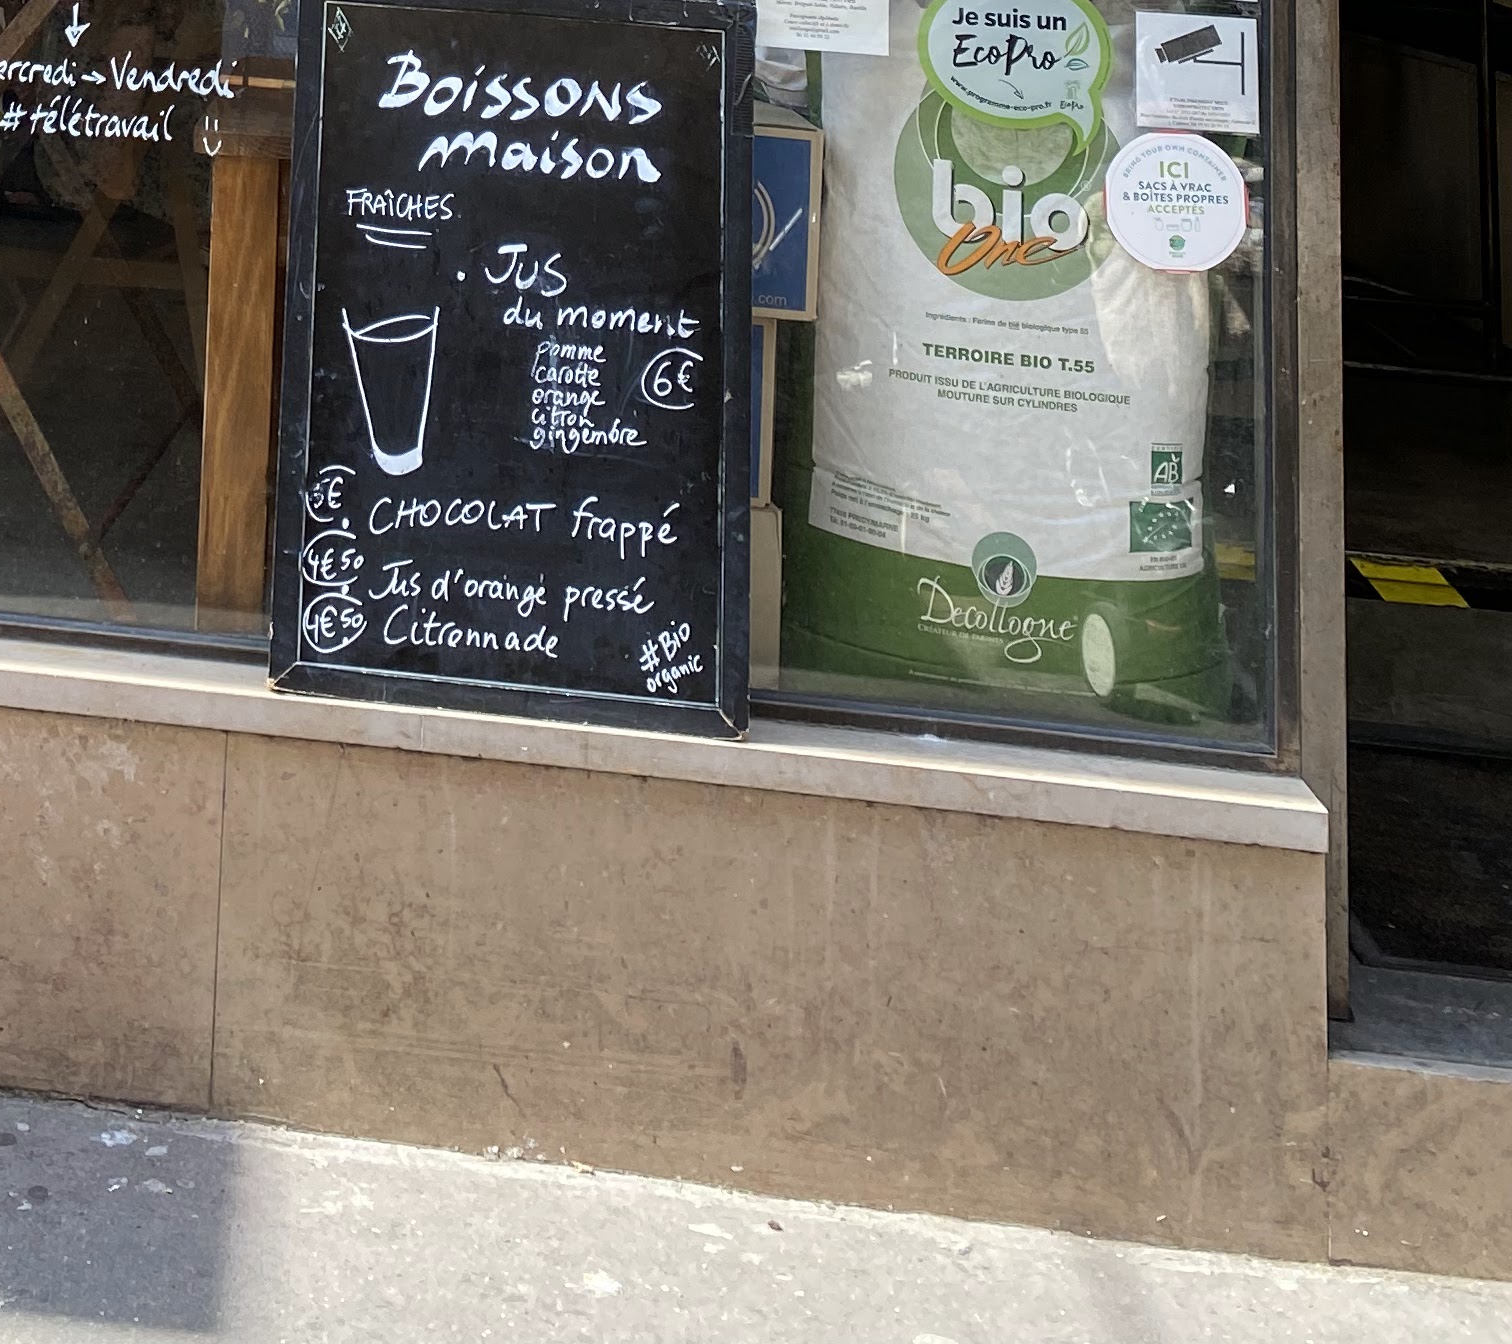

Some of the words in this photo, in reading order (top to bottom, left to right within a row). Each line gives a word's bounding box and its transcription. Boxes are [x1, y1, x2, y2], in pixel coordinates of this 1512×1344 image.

[951, 7, 979, 26] Je
[984, 8, 1031, 29] suis
[1037, 14, 1067, 31] un
[952, 33, 1063, 76] EcoPro
[110, 55, 239, 101] Vendredi
[1122, 156, 1142, 179] BRING
[1140, 145, 1164, 159] YOUR
[1164, 144, 1186, 153] OWN
[1187, 147, 1228, 182] CONTAINER
[1159, 161, 1189, 179] ICI
[1122, 191, 1131, 202] &
[1133, 189, 1173, 203] BOÎTES
[1176, 193, 1229, 205] PROPRES
[1138, 180, 1167, 191] SACS
[1170, 178, 1179, 192] À
[1180, 182, 1212, 193] VRAC
[932, 158, 1090, 252] bio
[1147, 203, 1205, 216] ACCEPTÉS
[937, 220, 1090, 276] One
[503, 296, 543, 331] du
[557, 305, 701, 339] moment
[535, 339, 607, 365] pomme
[922, 342, 1015, 367] TERROIRE
[1020, 354, 1052, 370] BIO
[1058, 357, 1096, 374] T.55
[534, 363, 602, 387] carotte
[652, 359, 694, 397] 6€
[888, 368, 932, 385] PRODUIT
[934, 375, 959, 388] ISSU
[961, 379, 977, 390] DE
[978, 381, 1062, 399] L'AGRICULTURE
[1063, 390, 1131, 406] BIOLOGIQUE
[531, 388, 607, 417] orange
[937, 388, 990, 404] MOUTURE
[992, 395, 1015, 407] SUR
[1017, 398, 1078, 413] CYLINDRES
[530, 418, 648, 453] gingembre
[531, 408, 595, 429] citron
[1153, 461, 1179, 483] AB
[369, 497, 557, 536] CHOCOLAT
[572, 495, 681, 561] frappé
[564, 577, 655, 622] pressé
[384, 604, 560, 659] Citronnade
[646, 653, 704, 694] organic
